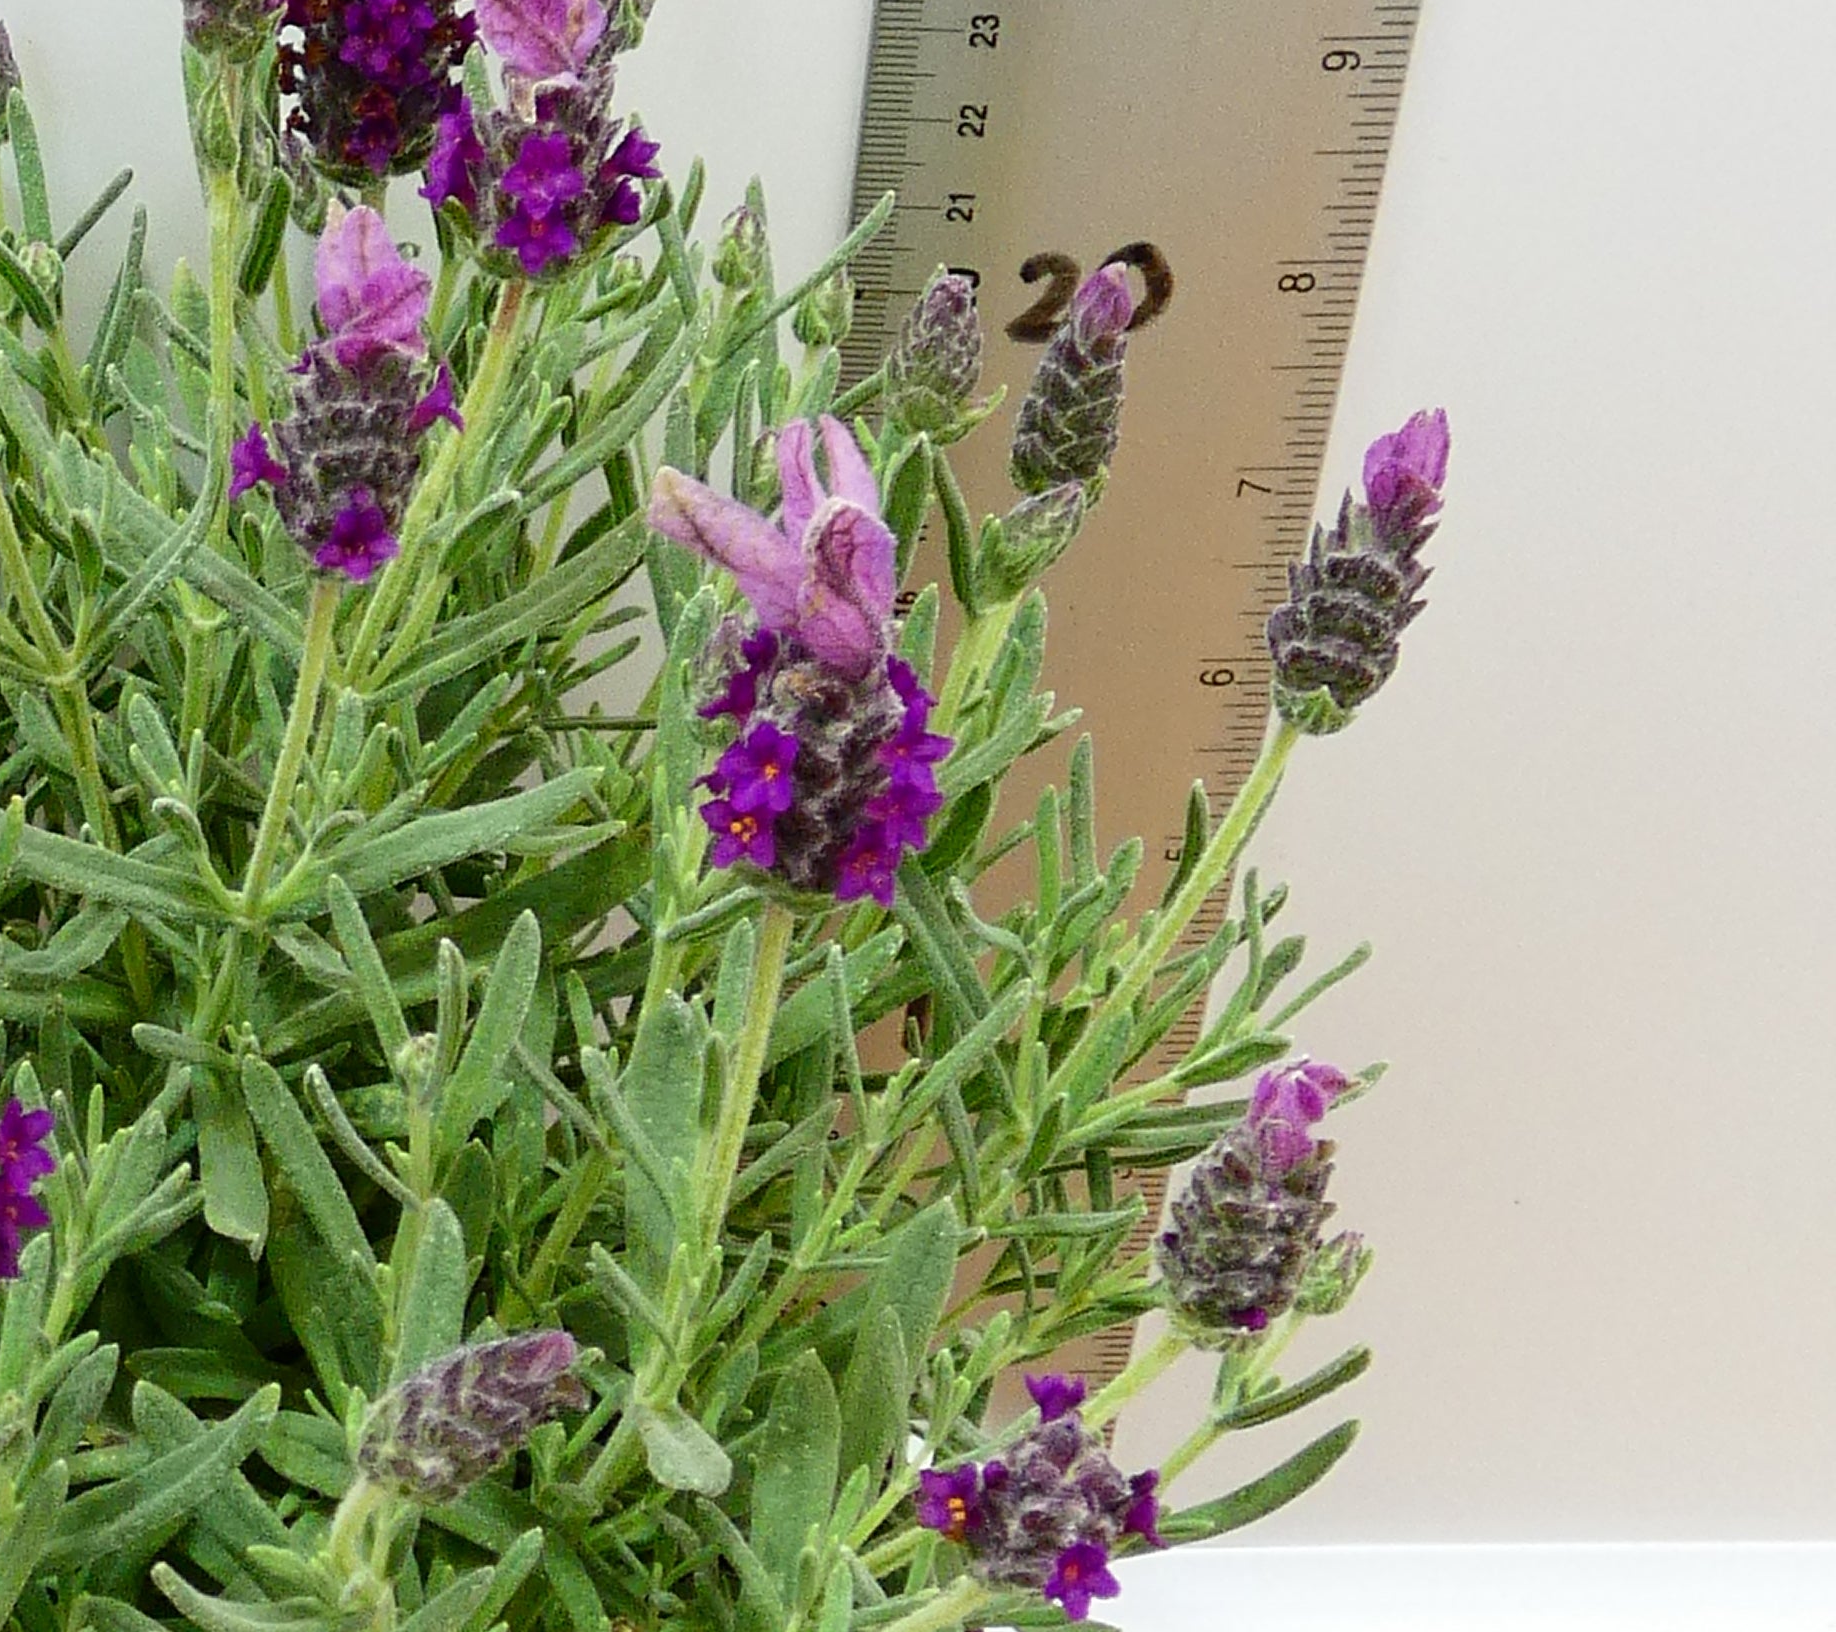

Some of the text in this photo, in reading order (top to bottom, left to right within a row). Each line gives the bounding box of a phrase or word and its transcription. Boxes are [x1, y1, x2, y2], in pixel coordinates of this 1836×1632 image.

[968, 14, 1000, 49] 23
[1321, 50, 1361, 72] 9
[956, 103, 988, 138] 22
[945, 191, 977, 223] 21
[1277, 272, 1316, 294] 8
[1236, 478, 1272, 498] 7
[1199, 668, 1235, 687] 6
